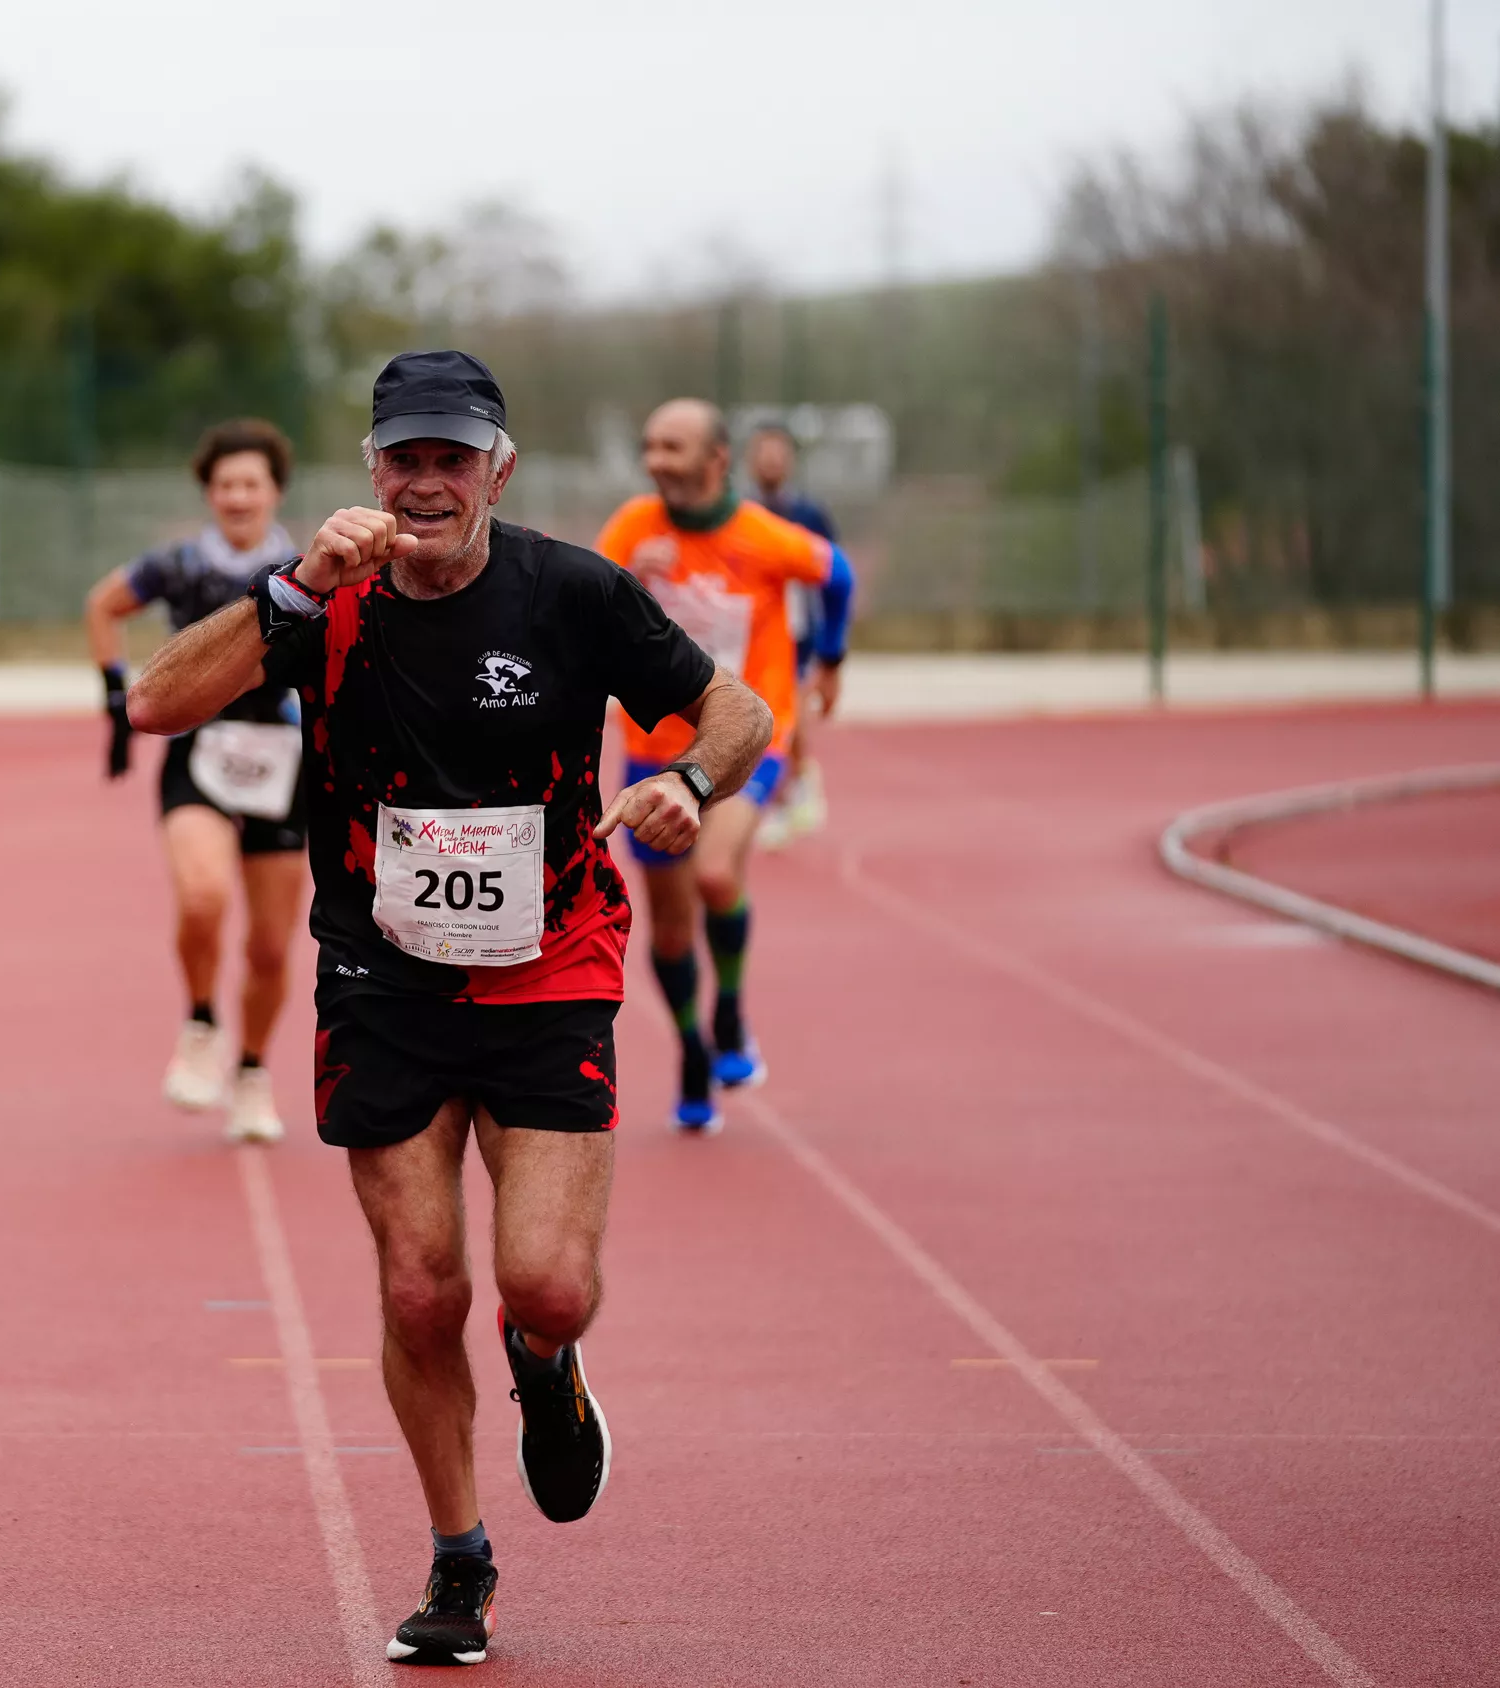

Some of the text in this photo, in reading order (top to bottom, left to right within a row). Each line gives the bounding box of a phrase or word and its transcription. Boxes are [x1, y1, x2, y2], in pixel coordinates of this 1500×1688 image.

[477, 651, 491, 664] CLUB
[501, 652, 532, 669] ATLETISMO
[418, 819, 436, 843] X
[438, 839, 493, 855] LUCENA
[414, 869, 504, 912] 205
[417, 919, 450, 929] FRANCISCO
[451, 922, 478, 931] CORDON
[443, 931, 473, 939] L-Hombre
